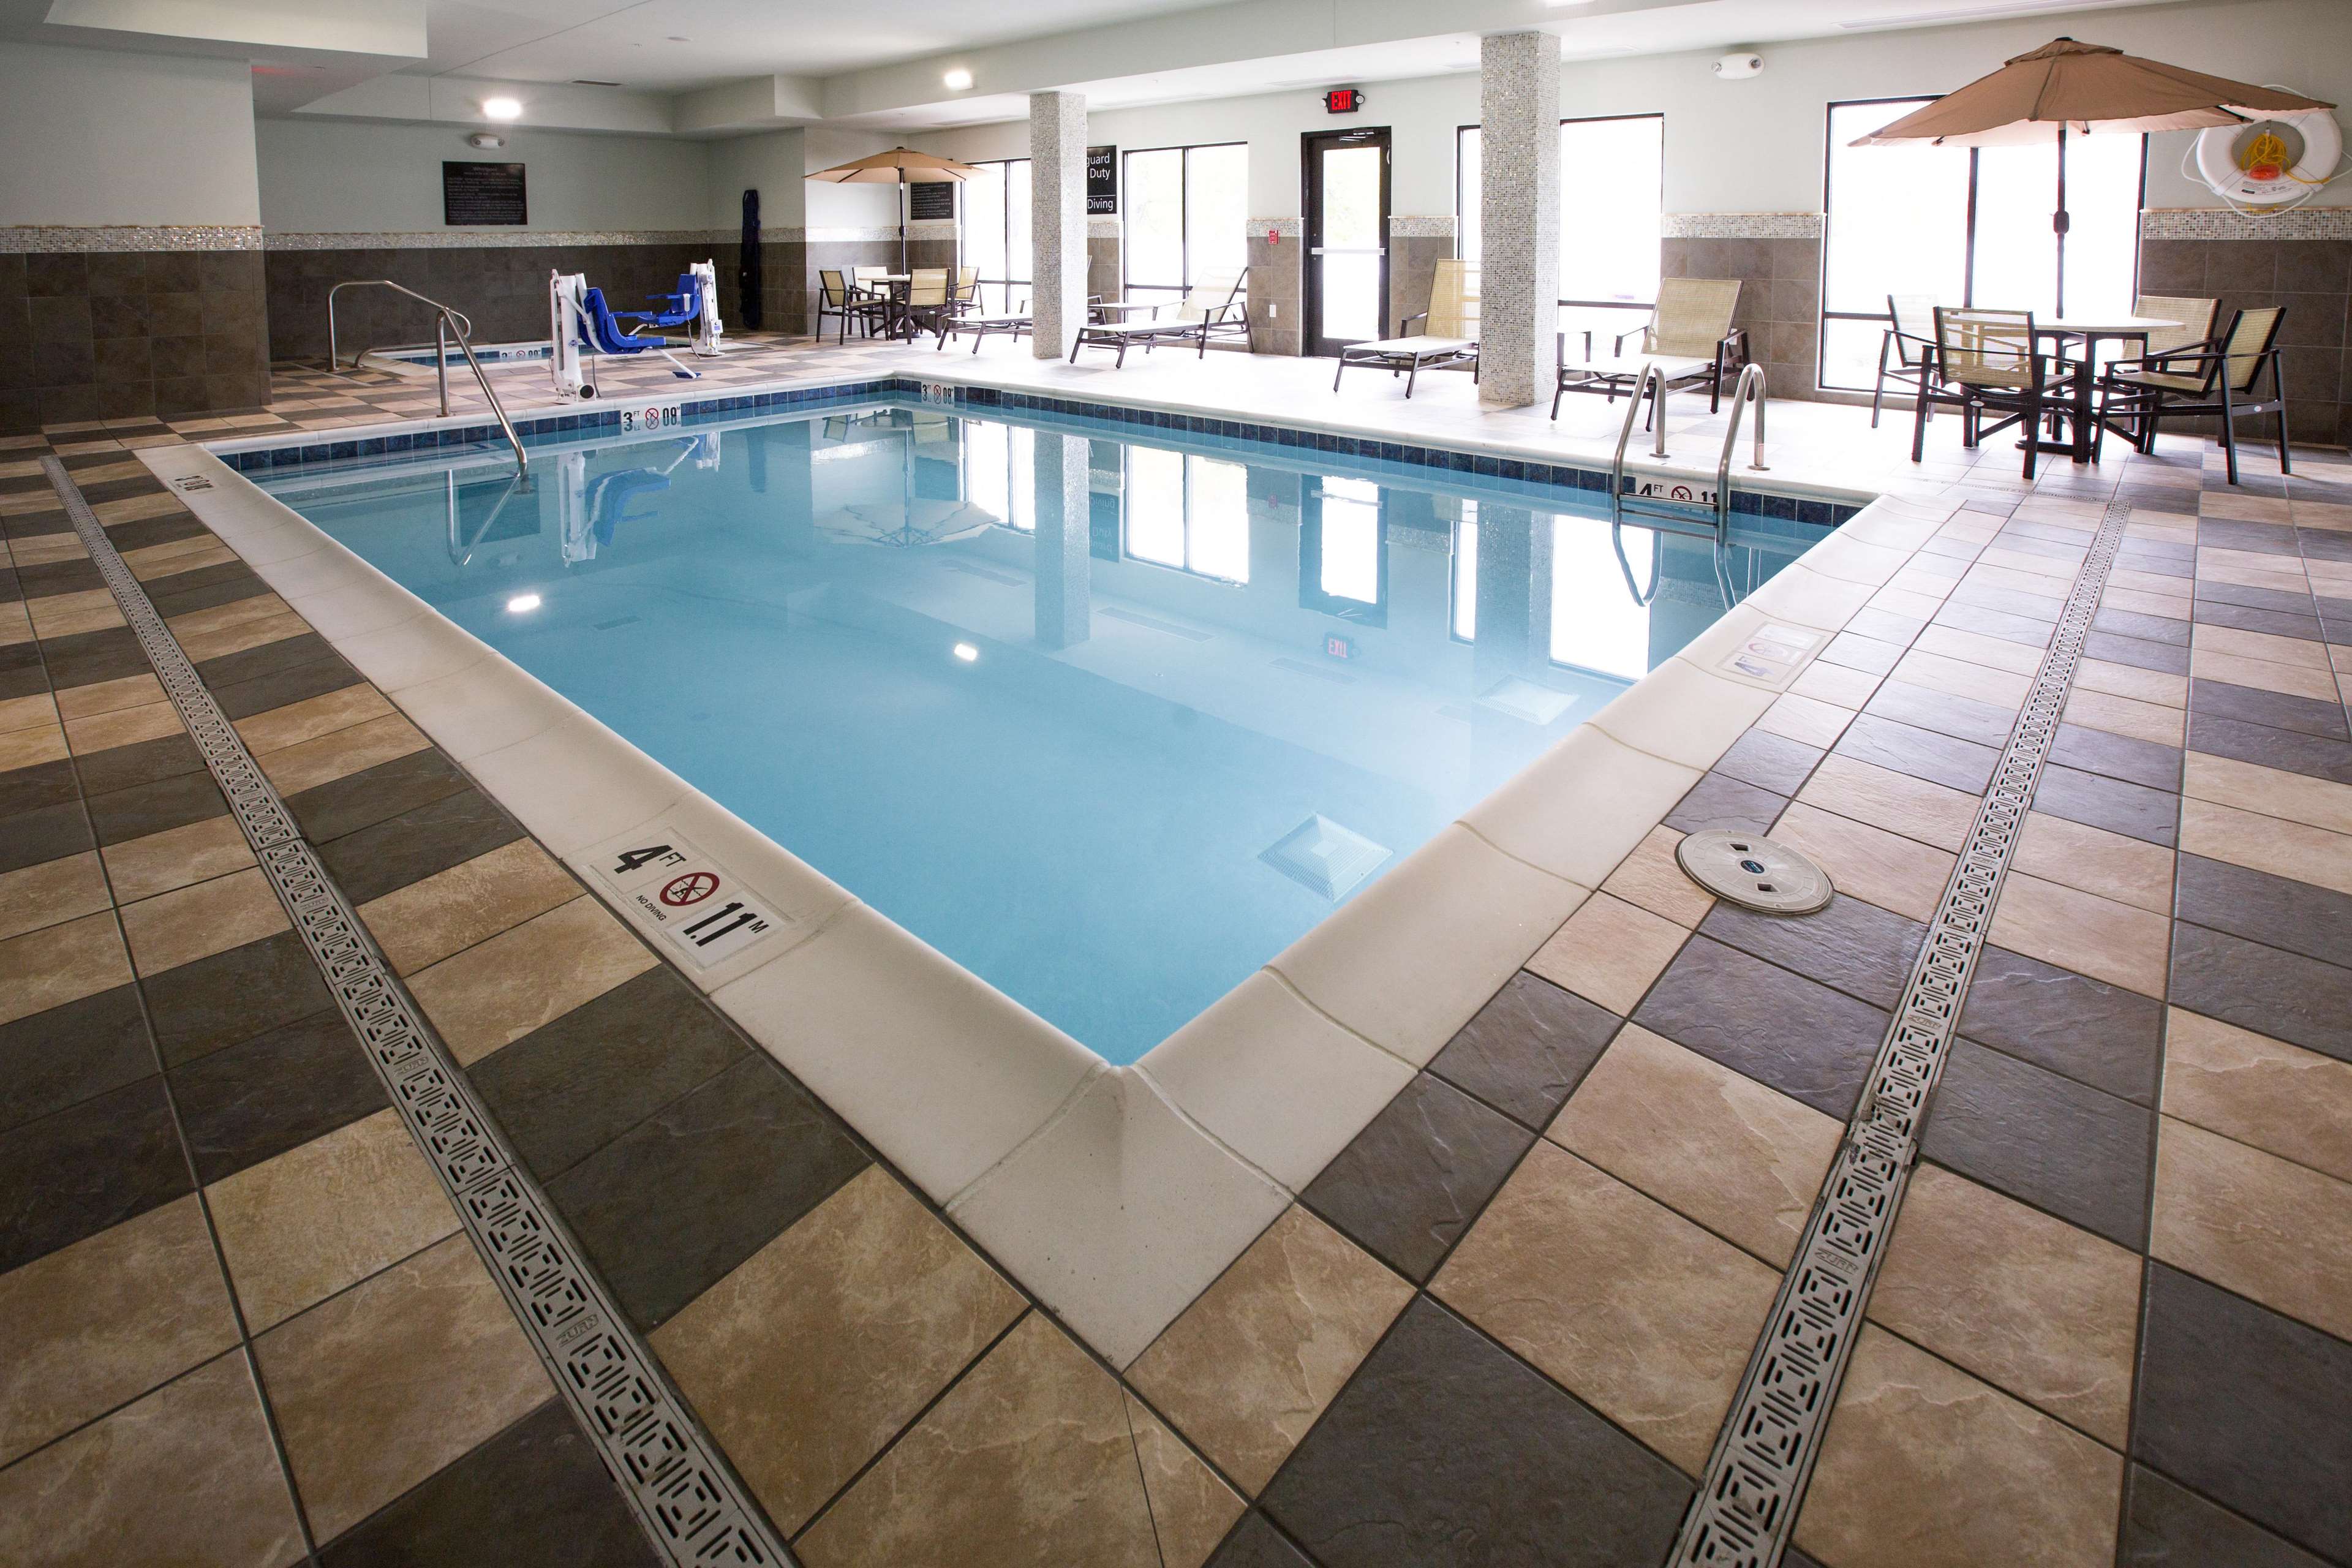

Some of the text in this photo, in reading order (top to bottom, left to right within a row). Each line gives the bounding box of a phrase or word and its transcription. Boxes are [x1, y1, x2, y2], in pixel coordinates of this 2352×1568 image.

[1332, 91, 1351, 110] EXIT
[1090, 168, 1110, 180] Duty
[1087, 198, 1114, 211] Diving
[614, 845, 686, 874] 4 FT
[636, 895, 666, 921] NO DIVING
[683, 902, 769, 947] 1.1 M
[1814, 1246, 1859, 1275] ZURN
